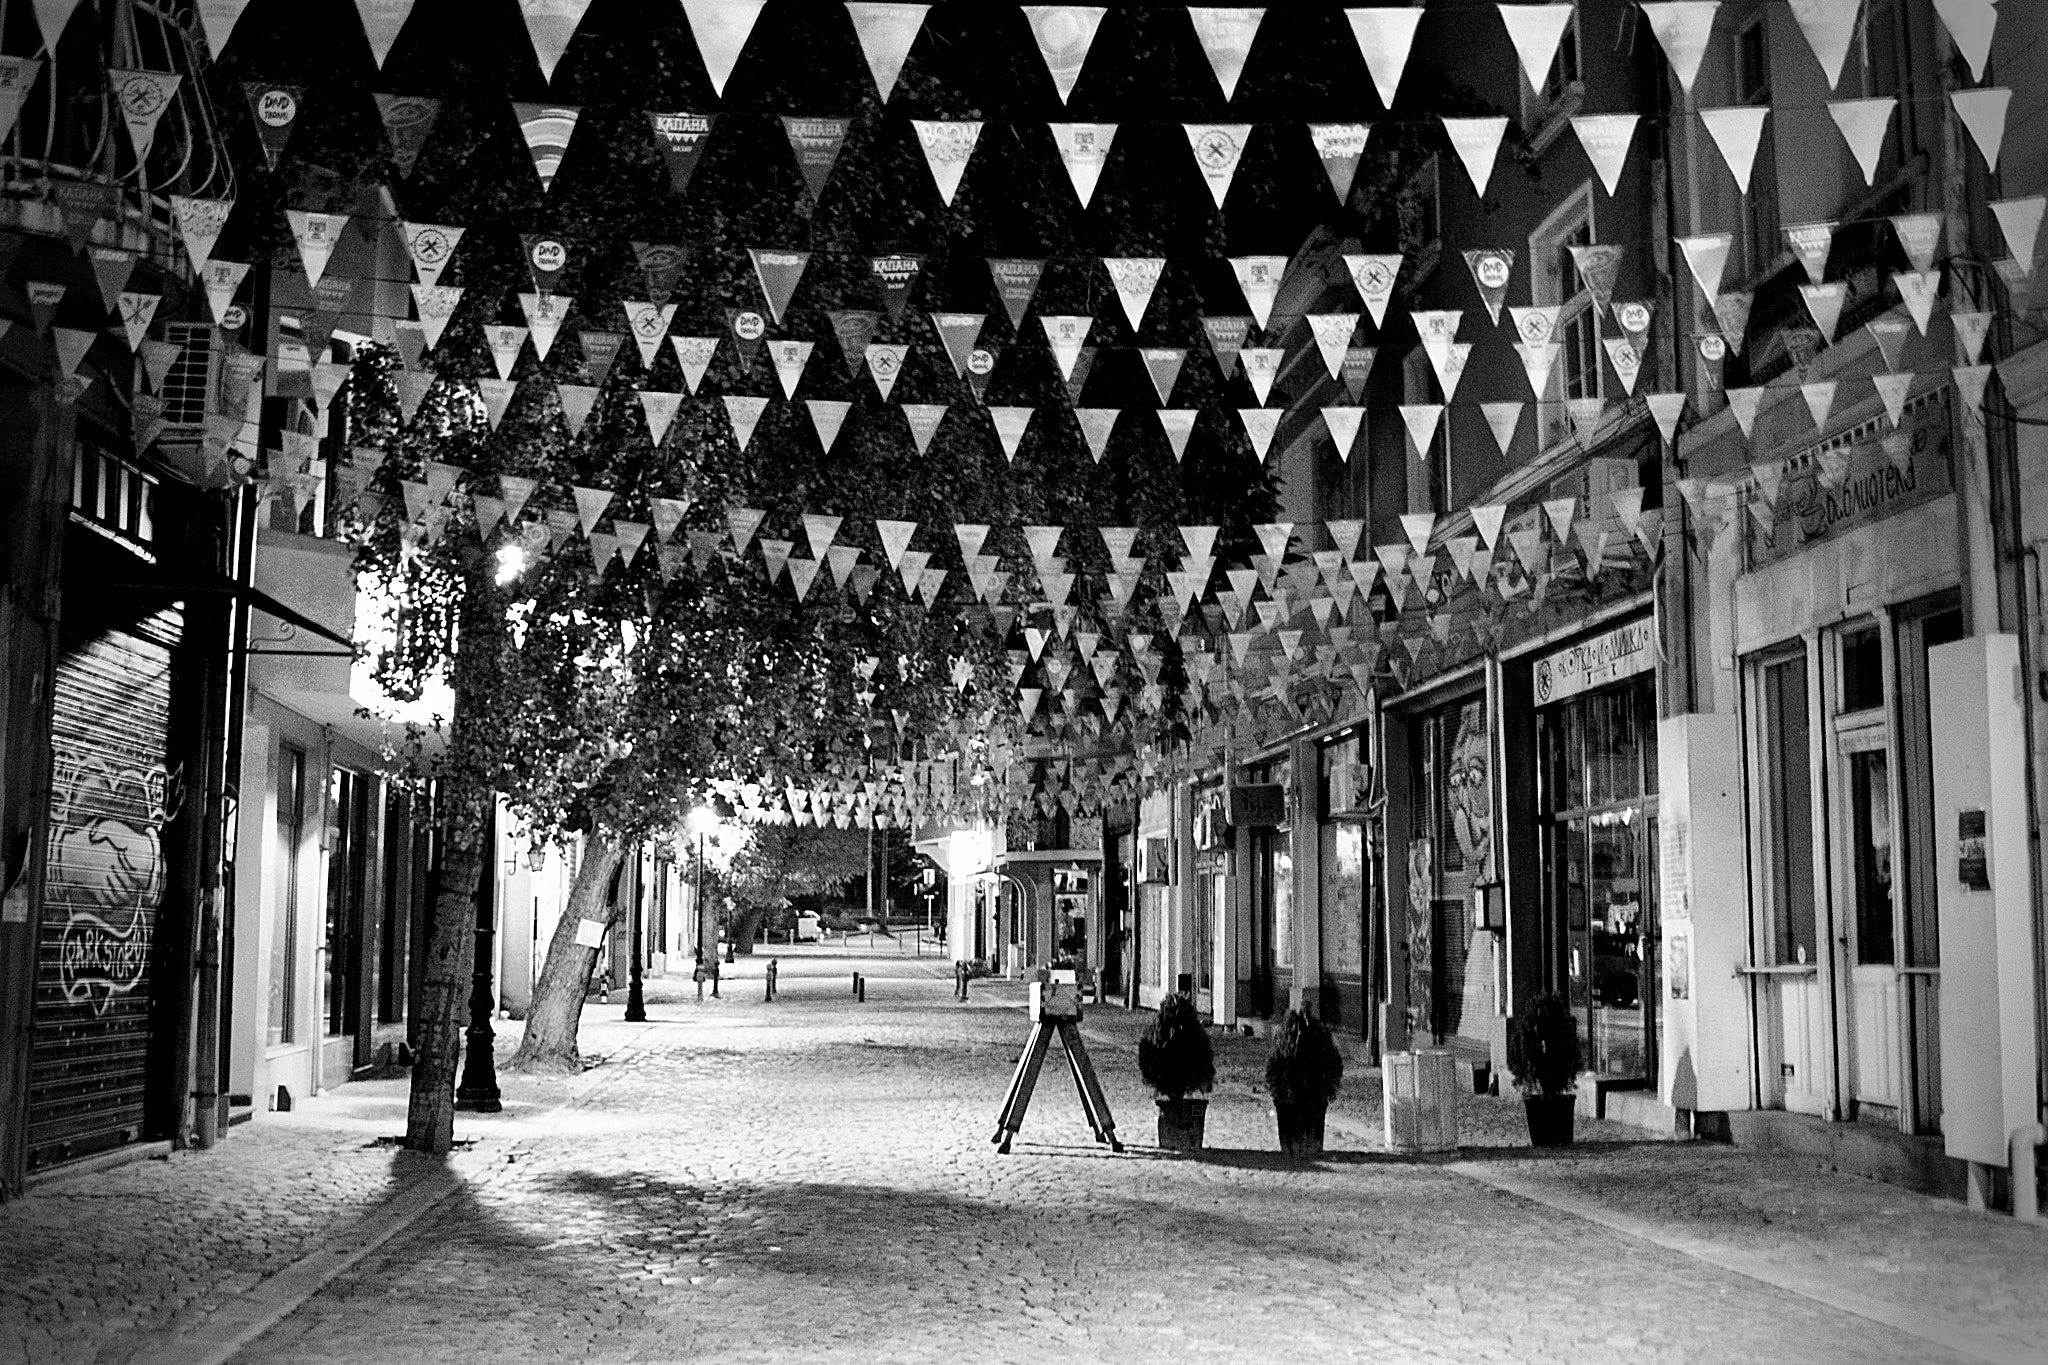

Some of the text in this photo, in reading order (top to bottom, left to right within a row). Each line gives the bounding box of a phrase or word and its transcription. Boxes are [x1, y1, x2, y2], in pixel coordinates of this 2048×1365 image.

[656, 117, 709, 133] КАПАНА
[791, 122, 843, 138] КАПАНА
[873, 260, 918, 272] КАПАНА
[995, 263, 1040, 276] КАПАНА
[1207, 320, 1247, 332] КАПАНА
